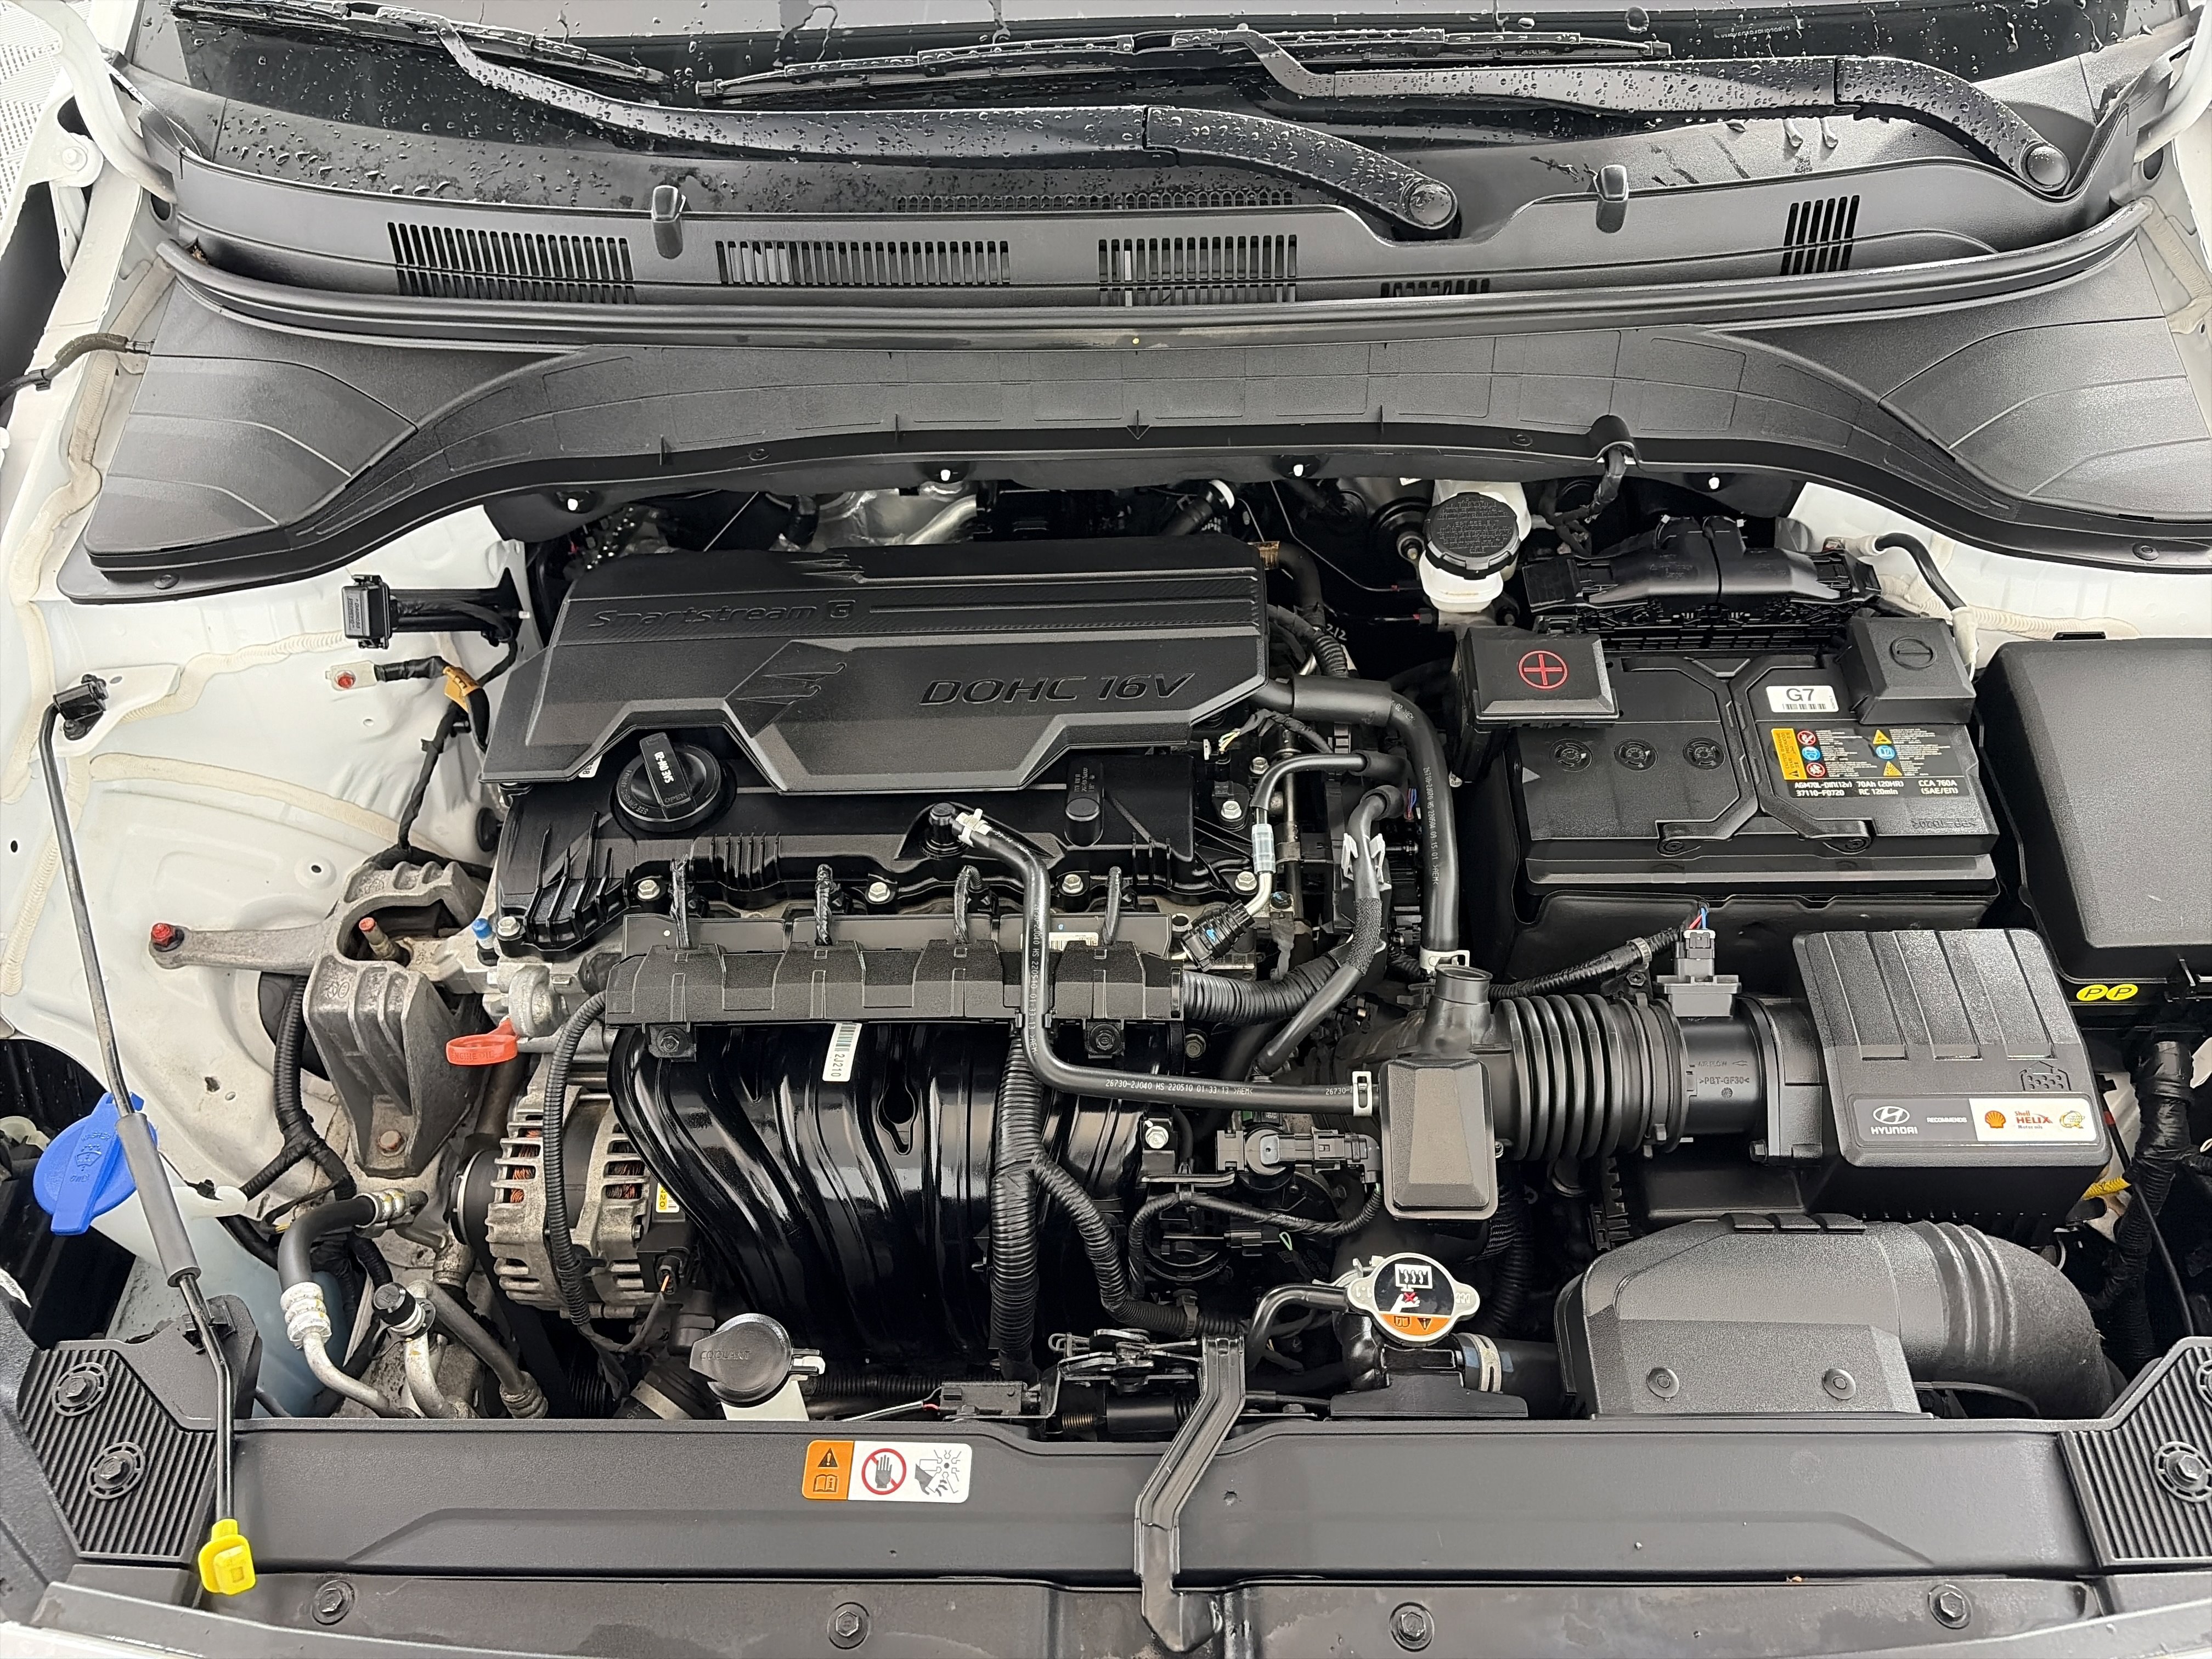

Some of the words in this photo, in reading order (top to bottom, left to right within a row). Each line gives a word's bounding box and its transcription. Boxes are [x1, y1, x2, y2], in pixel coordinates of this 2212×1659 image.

[590, 606, 816, 628] Smartstream
[919, 676, 1087, 706] DOHC
[1097, 673, 1195, 701] 16V
[1786, 688, 1814, 701] G7
[664, 791, 688, 804] OPEN
[1032, 948, 1040, 957] HS
[1030, 961, 1039, 989] 220510
[2083, 986, 2099, 998] P
[2112, 986, 2132, 998] P
[831, 1053, 845, 1077] 2J210
[1105, 1079, 1153, 1091] 26730-2J040
[1155, 1081, 1165, 1091] HS
[1167, 1082, 1193, 1093] 220510
[1871, 1126, 1918, 1135] HYUNDAI
[699, 1349, 752, 1361] COOLANT
